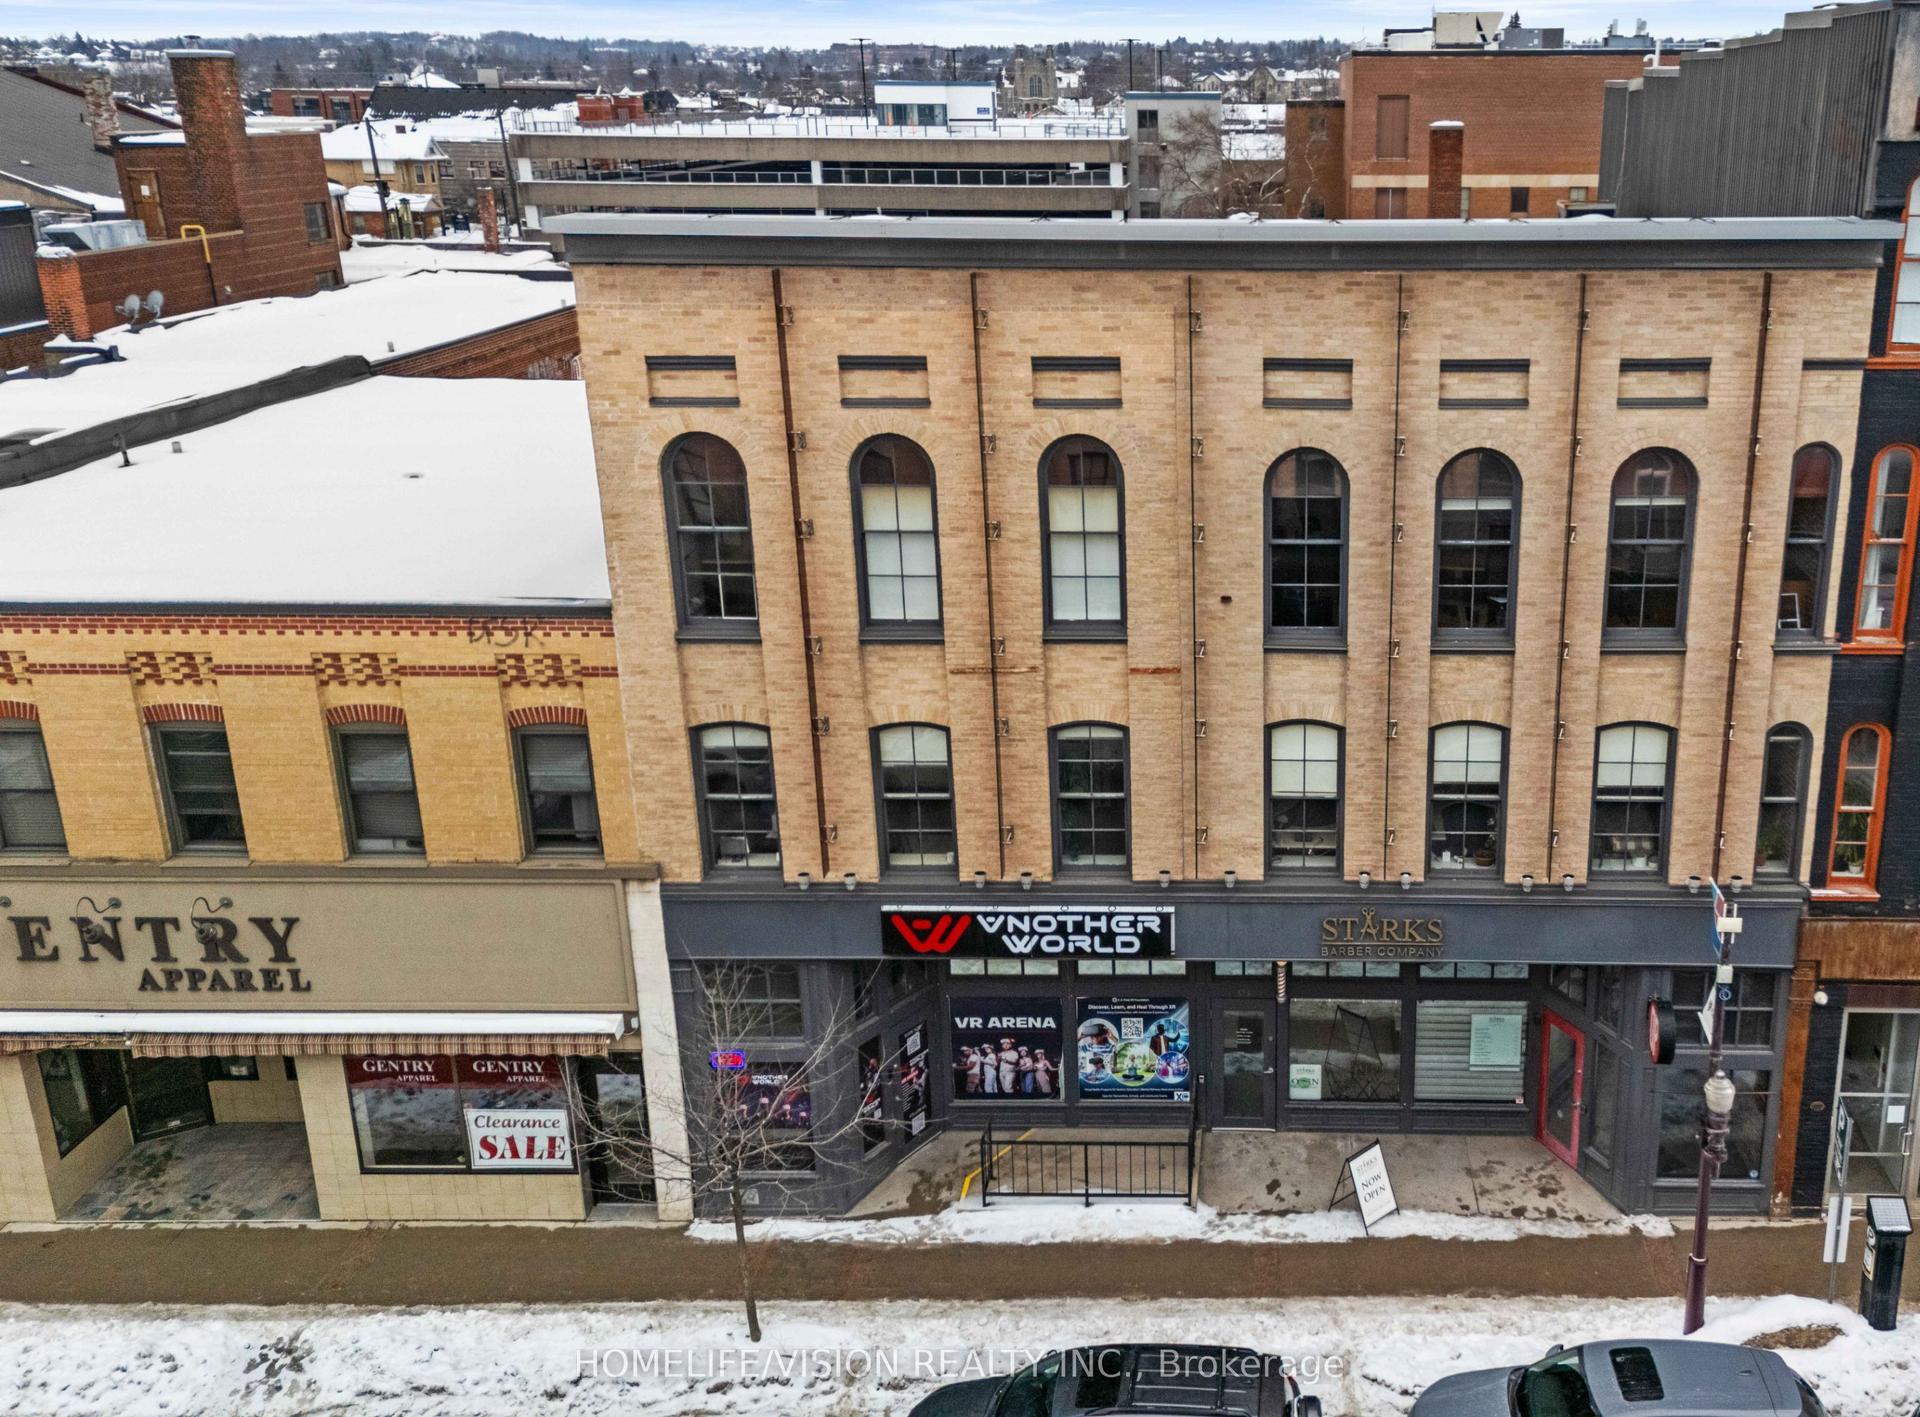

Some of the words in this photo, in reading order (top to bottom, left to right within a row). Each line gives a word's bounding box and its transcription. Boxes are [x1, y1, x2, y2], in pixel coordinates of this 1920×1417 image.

[1321, 907, 1444, 943] STARKS
[7, 916, 300, 963] ENTRY
[1001, 934, 1141, 954] WORLD
[1321, 946, 1372, 957] BARBER
[1377, 946, 1444, 957] COMPANY
[138, 967, 312, 992] APPAREL
[954, 1016, 983, 1029] VR
[987, 1016, 1057, 1029] ARENA
[362, 1059, 436, 1073] GENTRY
[472, 1060, 545, 1073] GENTRY
[397, 1074, 439, 1082] APPAREL
[474, 1114, 561, 1129] Clearance
[479, 1134, 567, 1160] SALE
[1361, 1172, 1382, 1191] NOW
[1364, 1184, 1386, 1203] OPEN
